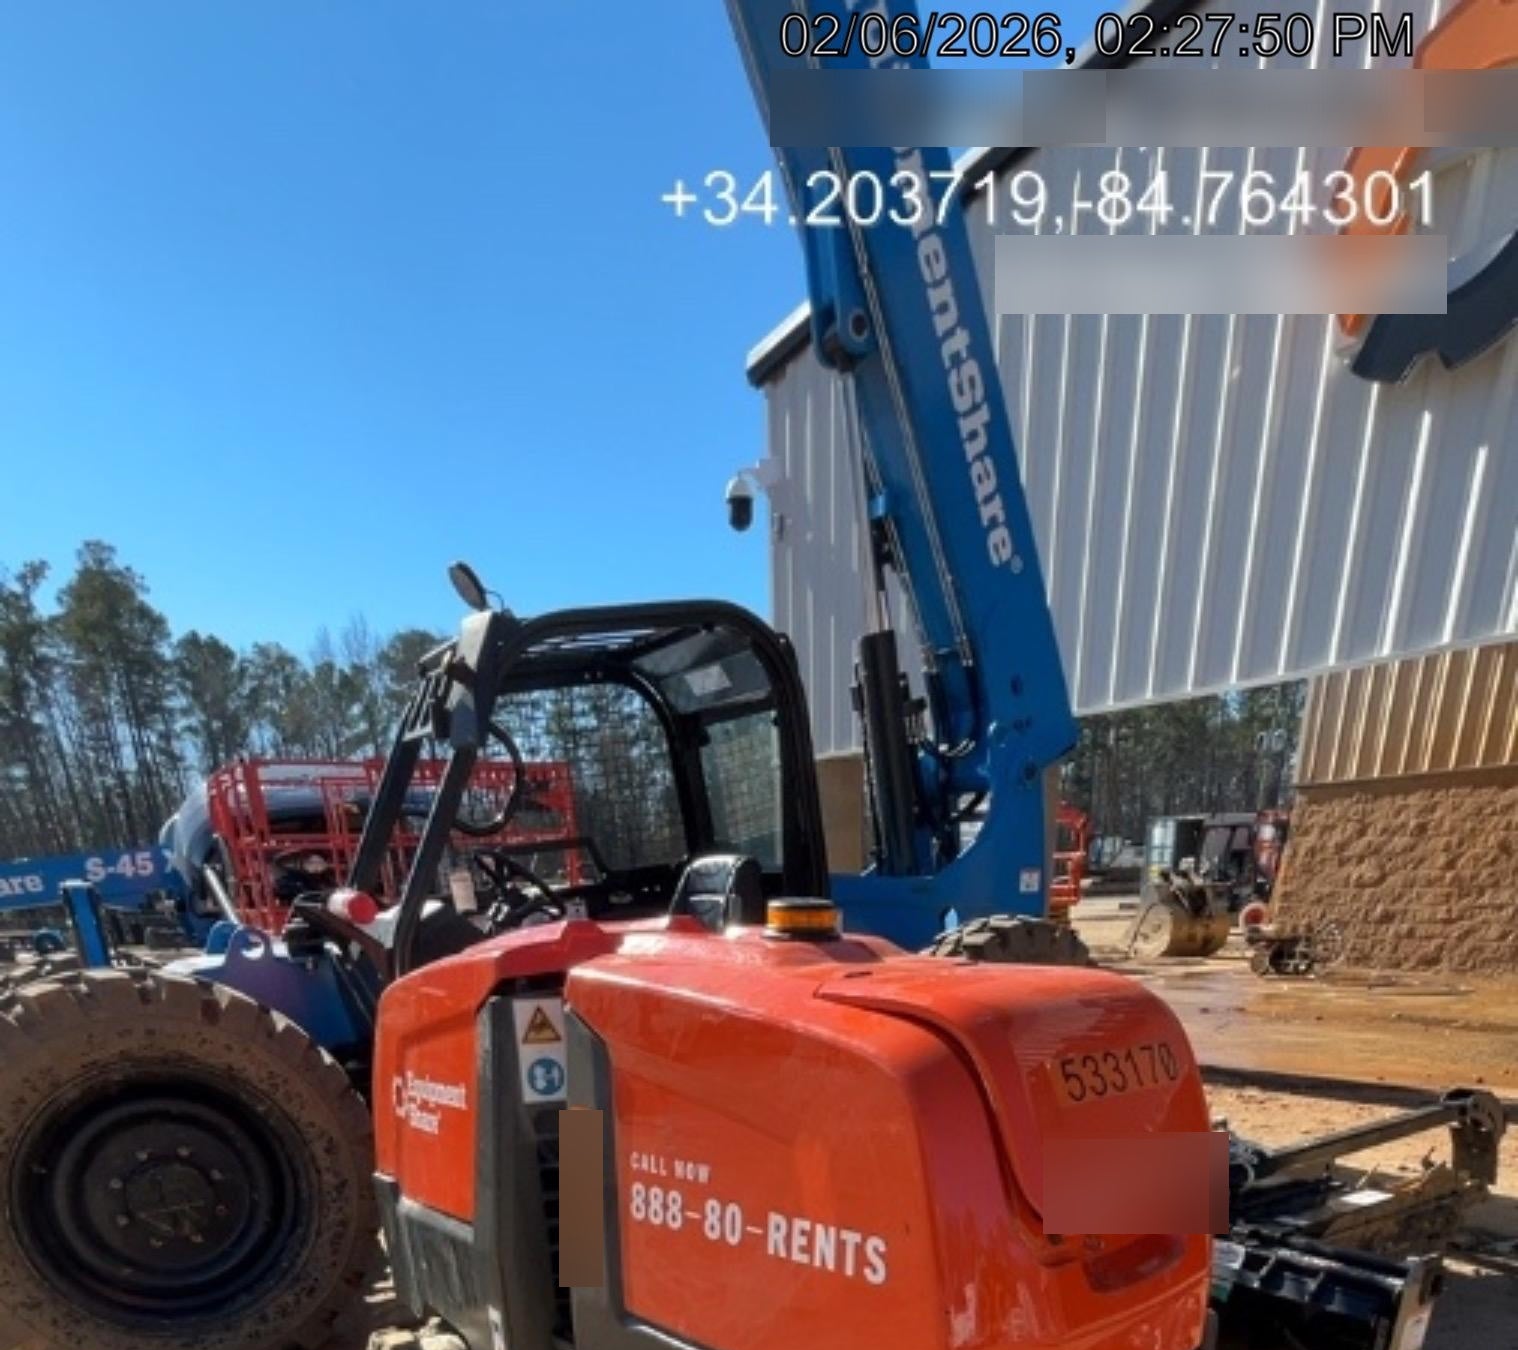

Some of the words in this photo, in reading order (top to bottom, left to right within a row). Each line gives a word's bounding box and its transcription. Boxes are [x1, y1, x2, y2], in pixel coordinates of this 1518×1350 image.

[85, 851, 154, 882] S-45
[1061, 1042, 1177, 1102] 533170
[630, 1151, 667, 1177] CALL
[674, 1158, 712, 1184] NOW
[630, 1181, 887, 1285] 888-80-RENTS
